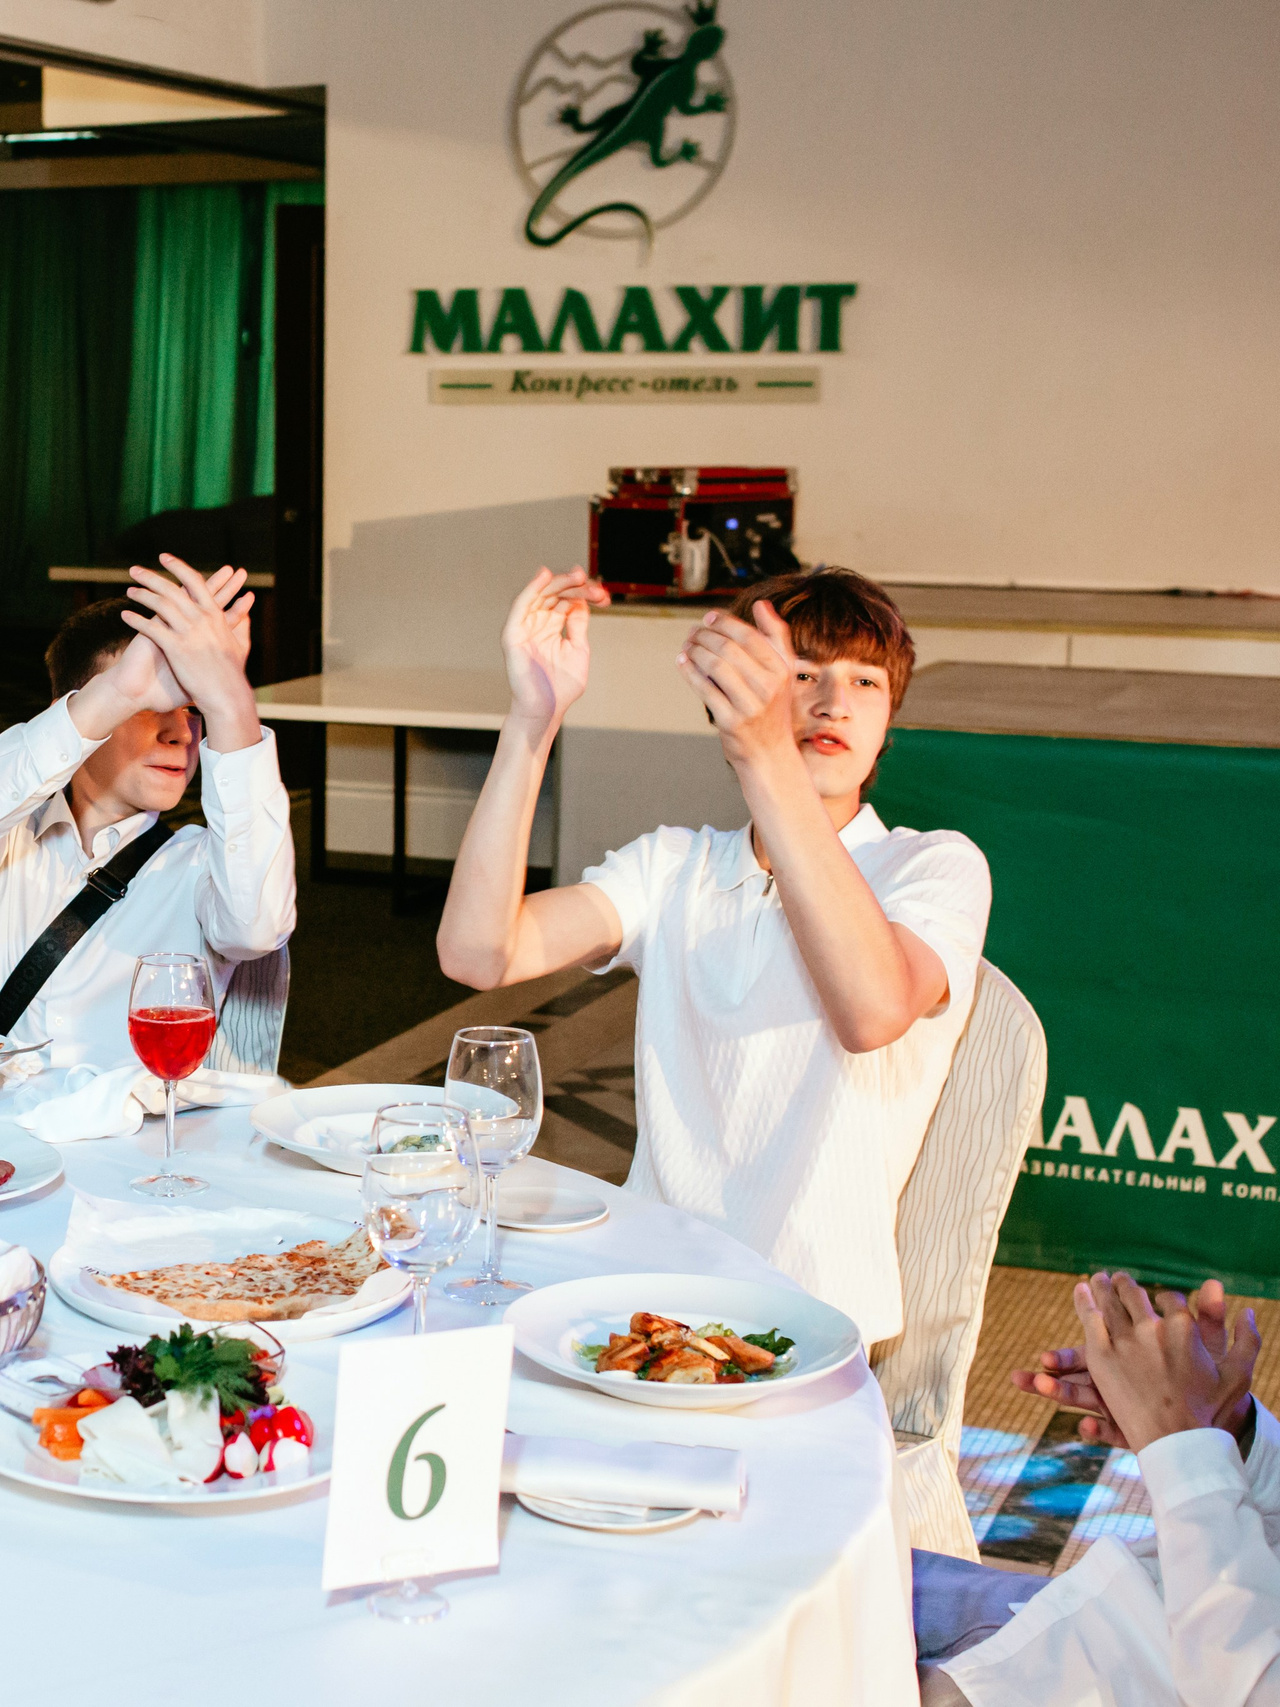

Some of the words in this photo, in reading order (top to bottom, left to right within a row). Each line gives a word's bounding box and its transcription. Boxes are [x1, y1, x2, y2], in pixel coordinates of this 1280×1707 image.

[407, 283, 857, 354] МАЛАХИТ
[511, 370, 739, 400] Конгресс-отель
[1028, 1095, 1277, 1175] АЛАХ
[1222, 1181, 1280, 1202] КОМП
[387, 1403, 447, 1521] 6
